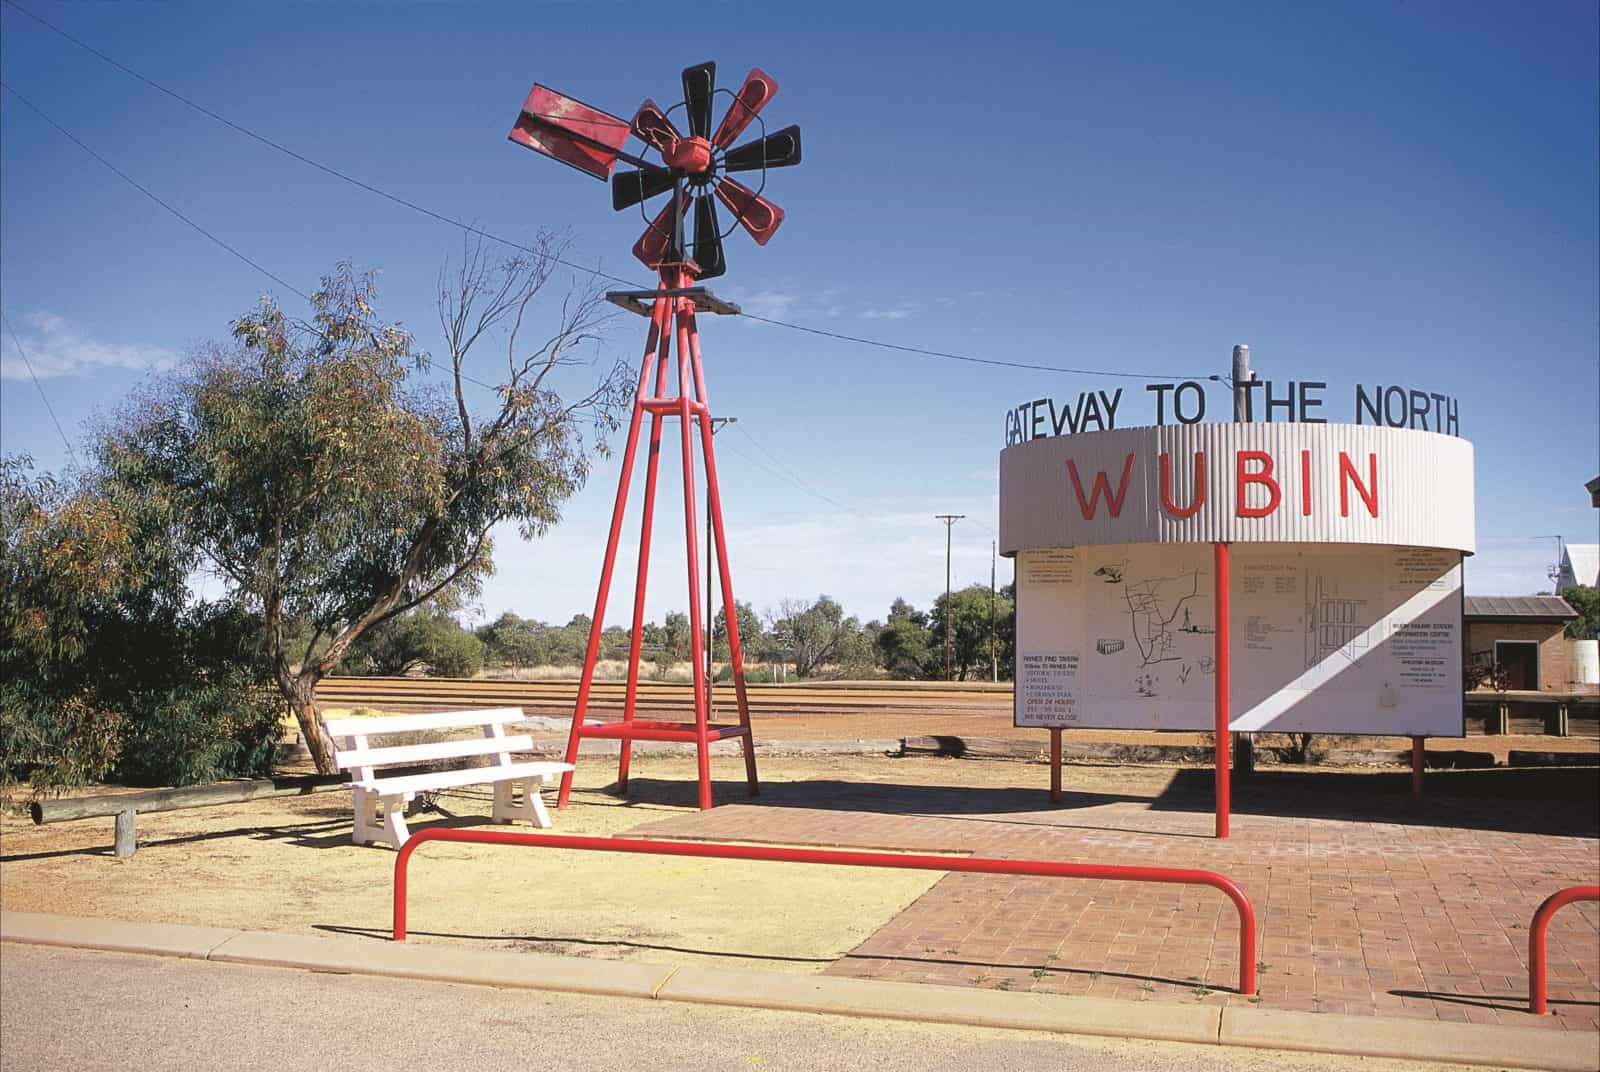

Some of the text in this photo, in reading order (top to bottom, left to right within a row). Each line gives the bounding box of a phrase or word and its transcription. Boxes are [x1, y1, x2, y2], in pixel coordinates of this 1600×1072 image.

[1005, 381, 1459, 447] GATEWAY TO THE NORTH
[1065, 450, 1379, 520] WUBIN
